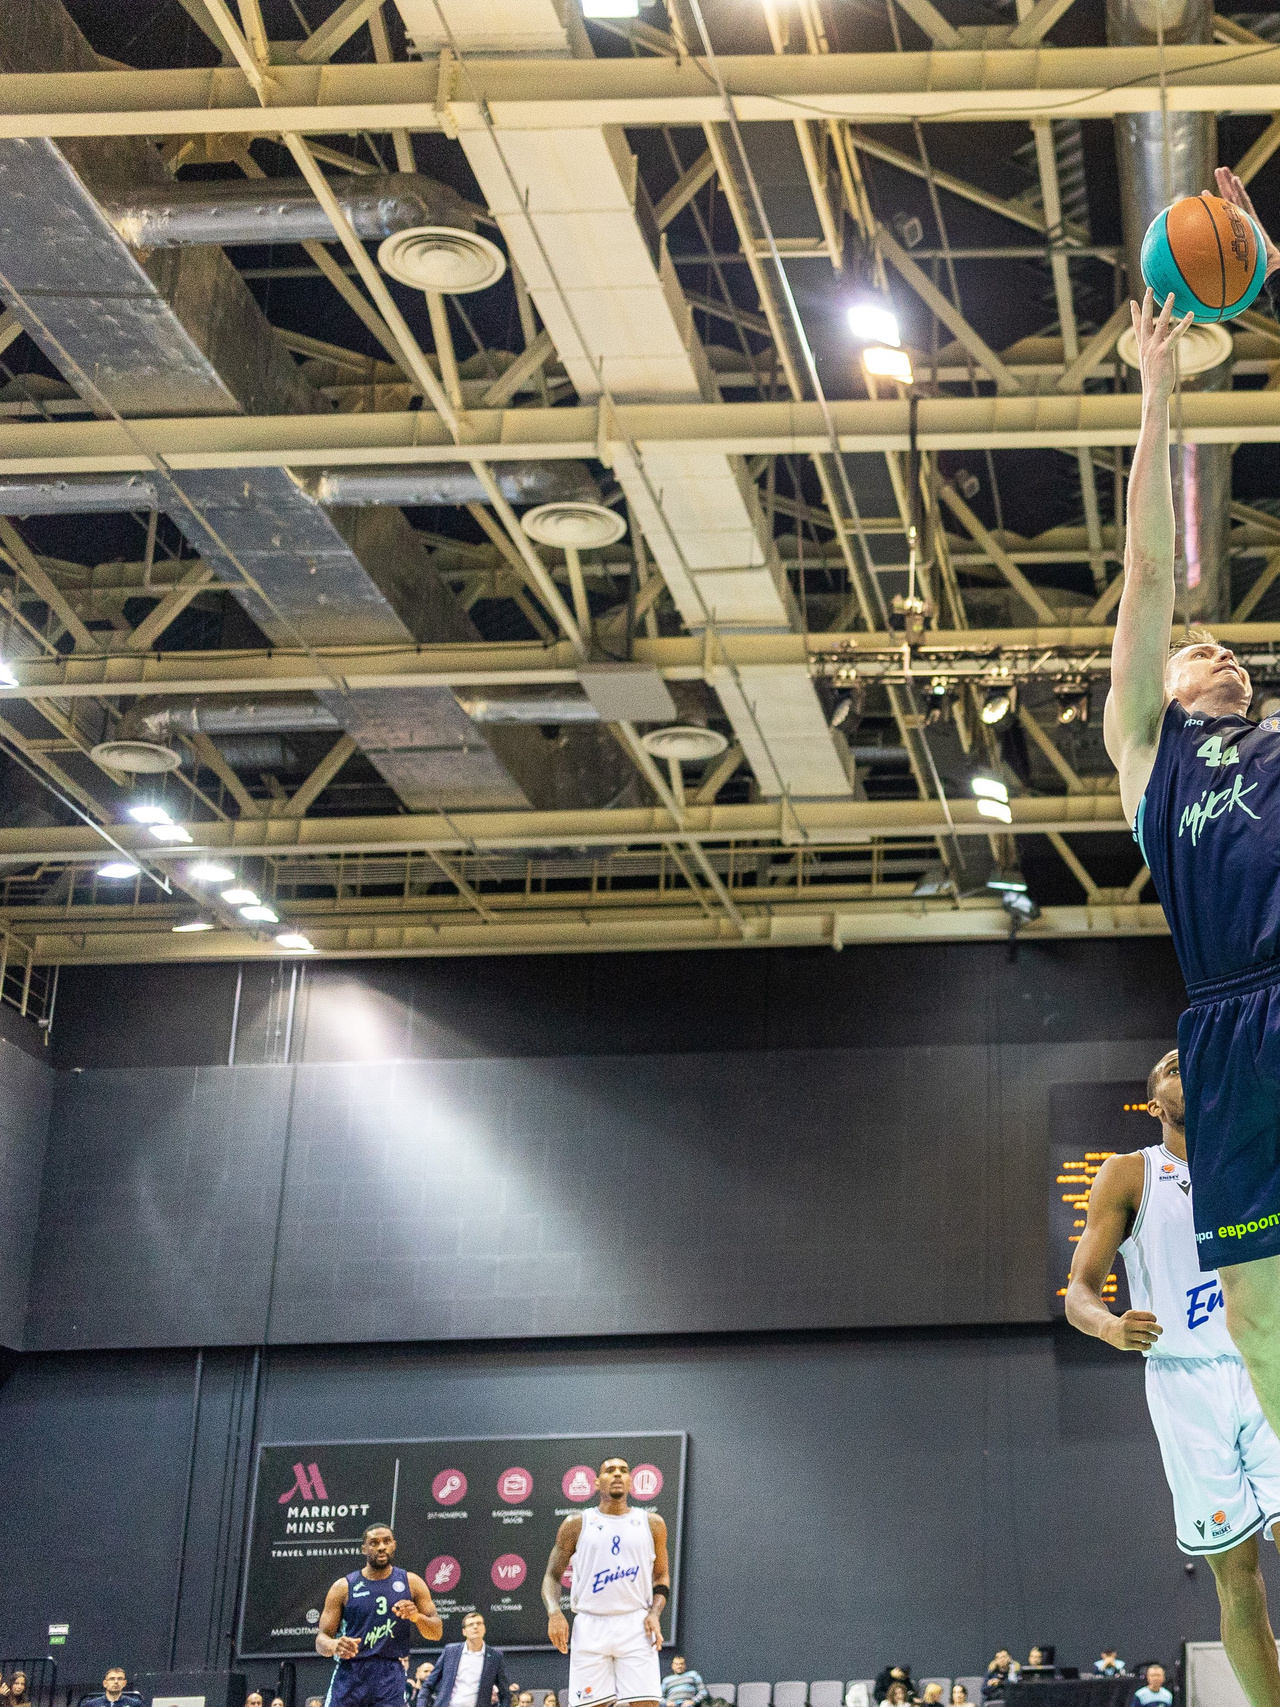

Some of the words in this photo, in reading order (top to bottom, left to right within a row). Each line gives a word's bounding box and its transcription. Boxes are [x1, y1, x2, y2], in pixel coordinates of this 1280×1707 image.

[1196, 735, 1240, 767] 44
[287, 1504, 369, 1518] MARRIOTT
[286, 1521, 335, 1534] MINSK
[1212, 1525, 1231, 1537] ENISEY
[271, 1549, 303, 1558] TRAVEL
[306, 1547, 362, 1557] BRILLIANTL
[611, 1535, 621, 1556] 8
[498, 1565, 522, 1578] VIP
[592, 1565, 639, 1594] Enisey
[375, 1596, 388, 1616] 3
